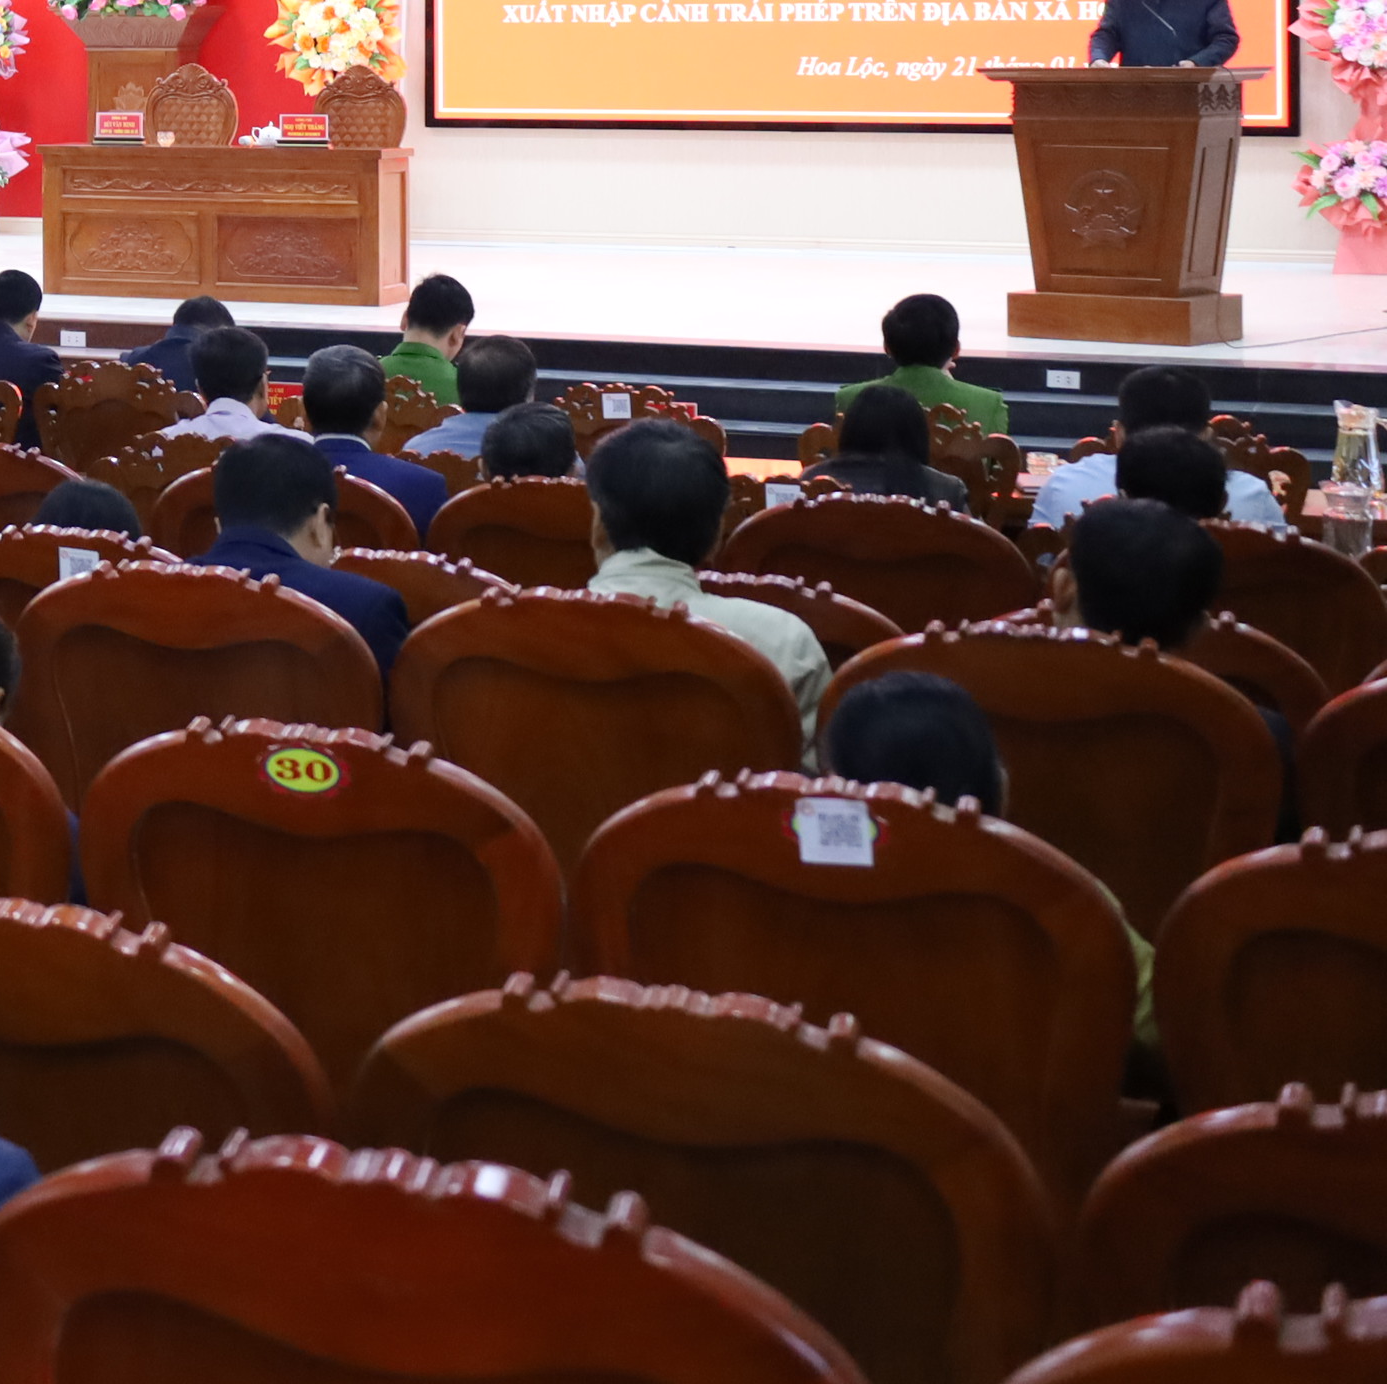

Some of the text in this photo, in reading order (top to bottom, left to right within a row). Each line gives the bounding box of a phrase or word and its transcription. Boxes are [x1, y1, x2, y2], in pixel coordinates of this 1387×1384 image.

[502, 0, 567, 23] XUẤT
[571, 1, 636, 27] NHẬP
[923, 1, 969, 26] ĐỊA
[796, 56, 841, 76] Hoa
[845, 56, 888, 79] Lộc,
[896, 55, 947, 81] ngày
[951, 56, 977, 76] 21
[275, 757, 334, 783] 30
